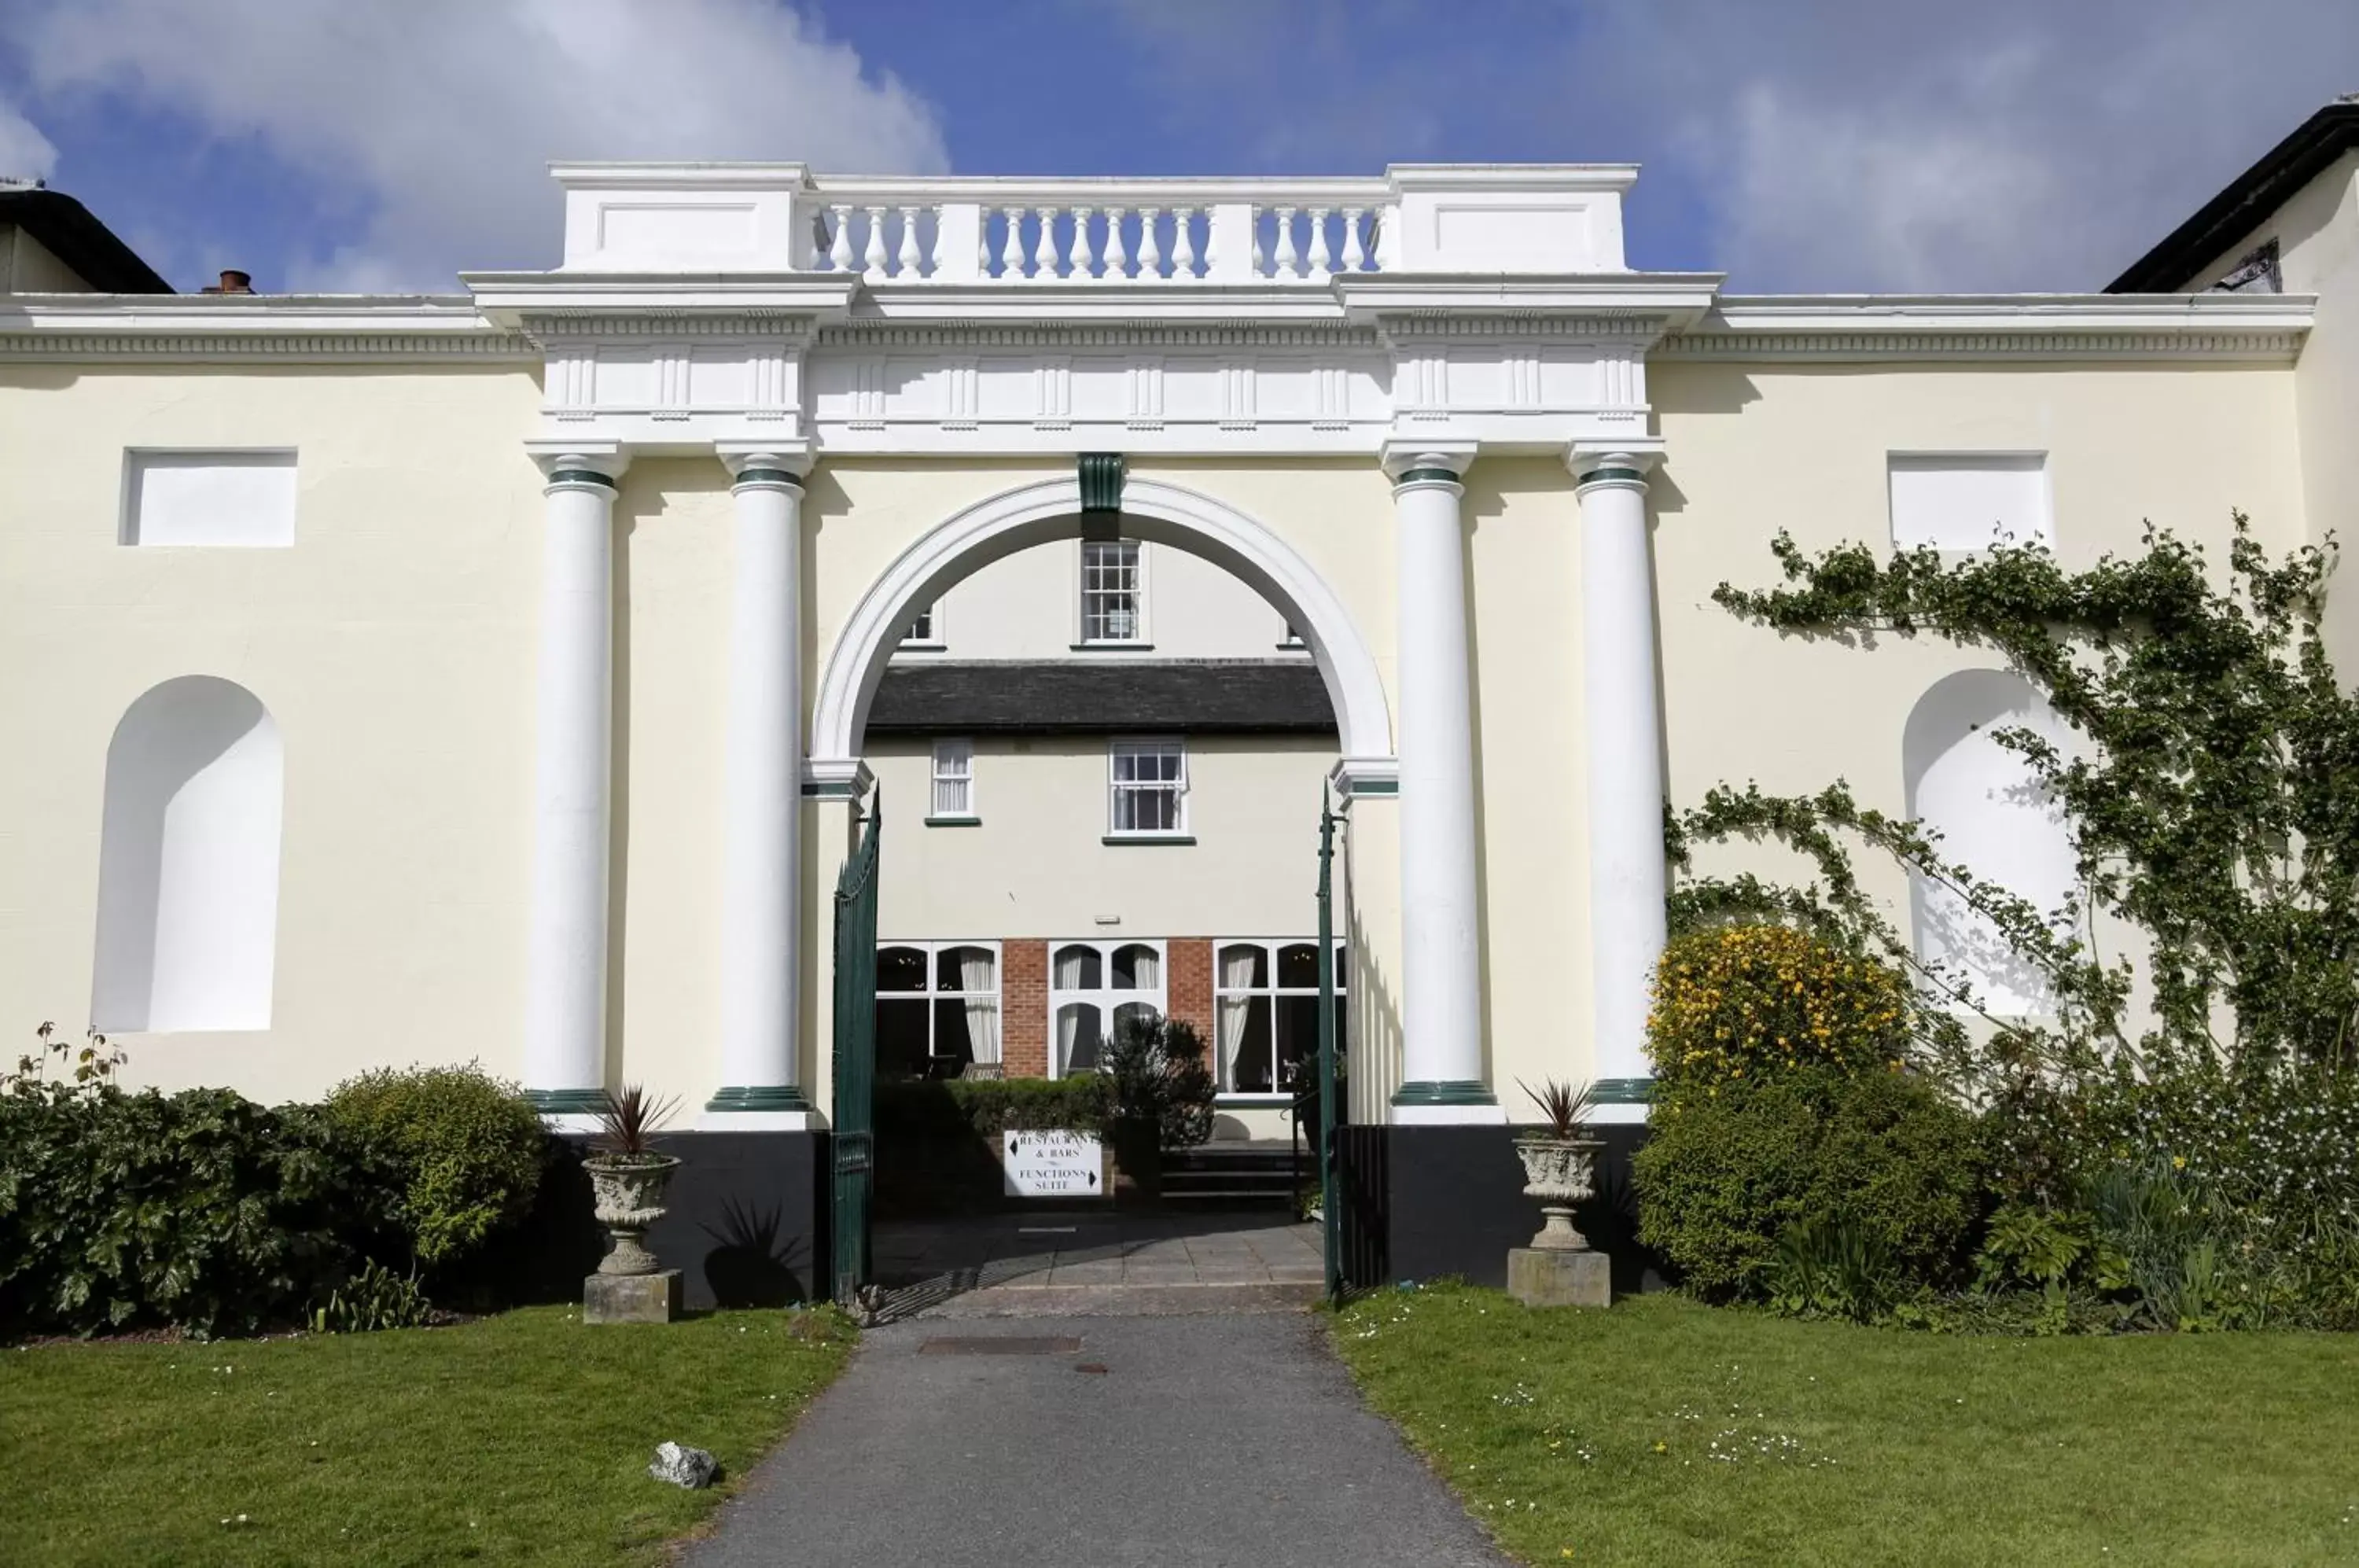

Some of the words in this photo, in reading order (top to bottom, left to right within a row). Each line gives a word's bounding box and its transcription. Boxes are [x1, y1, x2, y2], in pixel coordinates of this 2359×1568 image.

[1036, 1149, 1044, 1158] &
[1050, 1149, 1080, 1158] BARS
[1019, 1169, 1086, 1179] FUNCTIONS
[1035, 1181, 1068, 1190] SUITE
